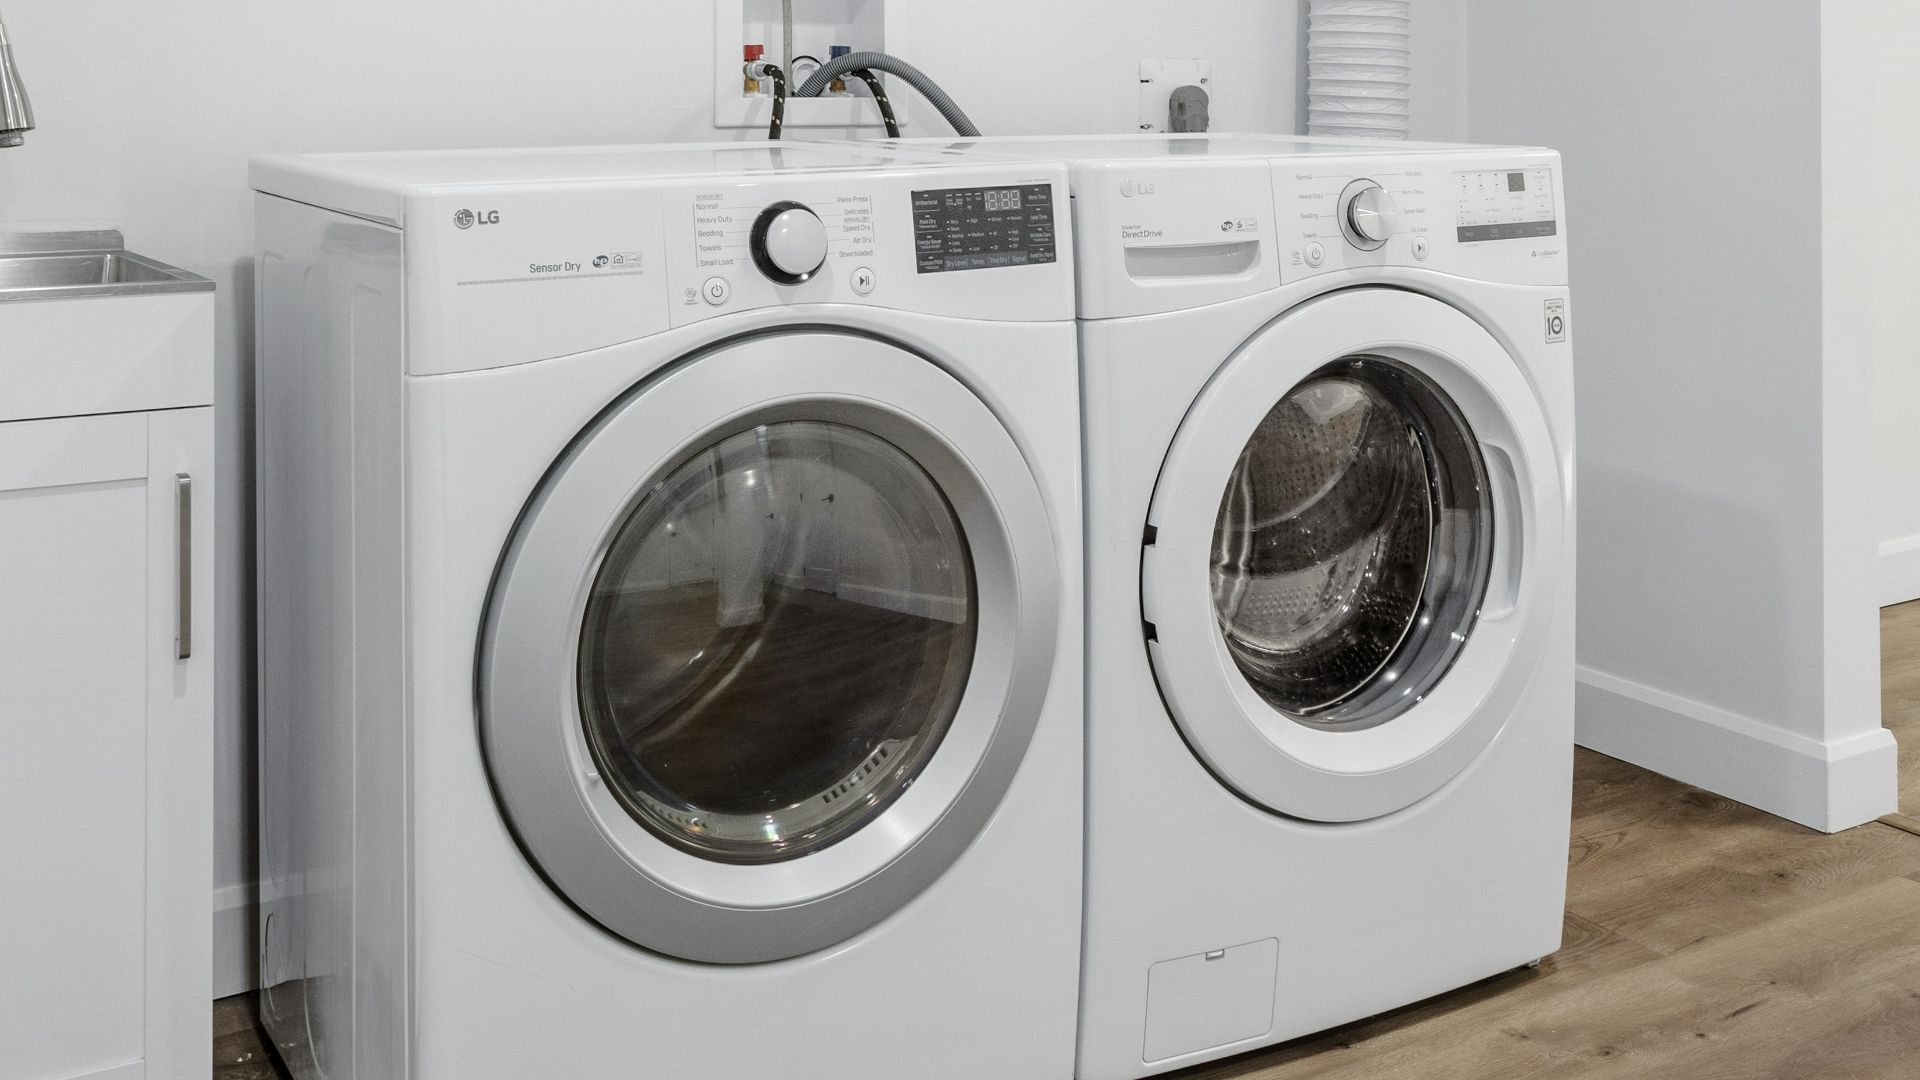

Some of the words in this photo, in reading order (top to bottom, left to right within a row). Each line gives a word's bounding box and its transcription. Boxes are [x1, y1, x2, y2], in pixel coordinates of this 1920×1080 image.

[1137, 182, 1155, 195] LG
[477, 210, 500, 225] LG
[718, 215, 733, 223] Duty
[842, 225, 860, 233] Speed
[861, 224, 871, 232] Dry
[529, 263, 562, 273] Sensor
[564, 261, 581, 273] Dry
[700, 259, 717, 267] Small
[718, 258, 734, 266] Load
[1547, 316, 1563, 336] 10
